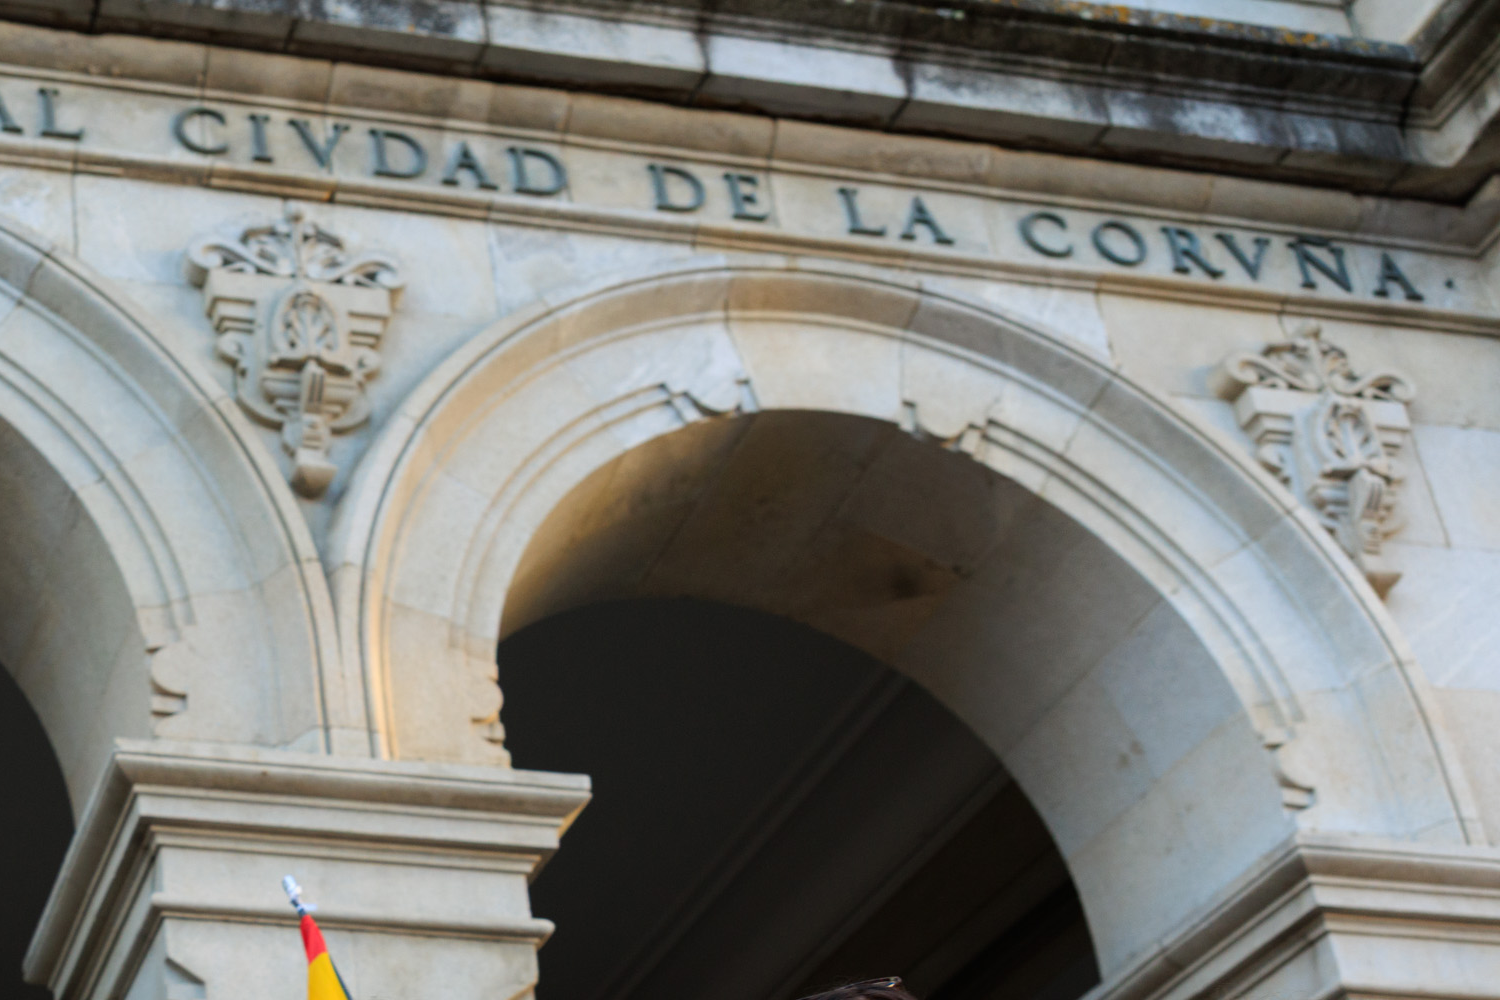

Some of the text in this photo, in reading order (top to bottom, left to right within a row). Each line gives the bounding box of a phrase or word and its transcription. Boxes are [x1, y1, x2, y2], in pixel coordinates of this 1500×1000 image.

[172, 106, 569, 197] CIVDAD
[646, 163, 771, 222] DE
[836, 187, 954, 246] LA
